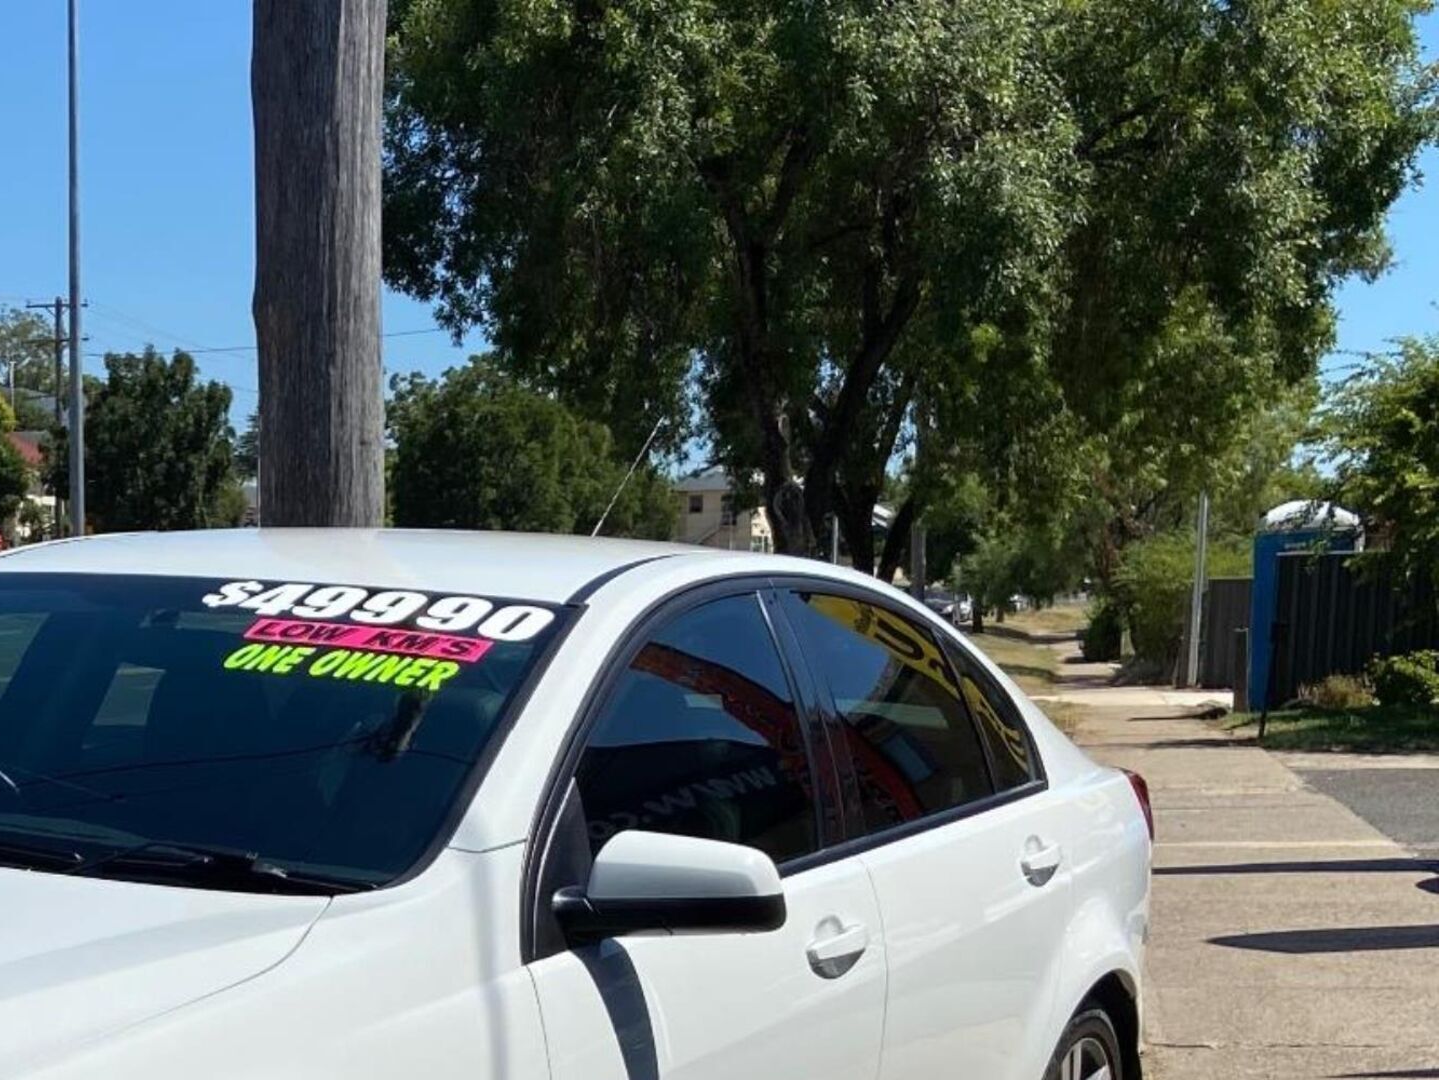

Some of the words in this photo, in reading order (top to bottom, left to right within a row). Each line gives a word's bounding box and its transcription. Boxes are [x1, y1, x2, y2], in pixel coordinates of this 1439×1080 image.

[202, 580, 555, 641] $49990
[253, 621, 352, 641] LOW
[364, 631, 482, 656] KM'S
[224, 644, 316, 673] ONE
[308, 648, 459, 690] OWNER
